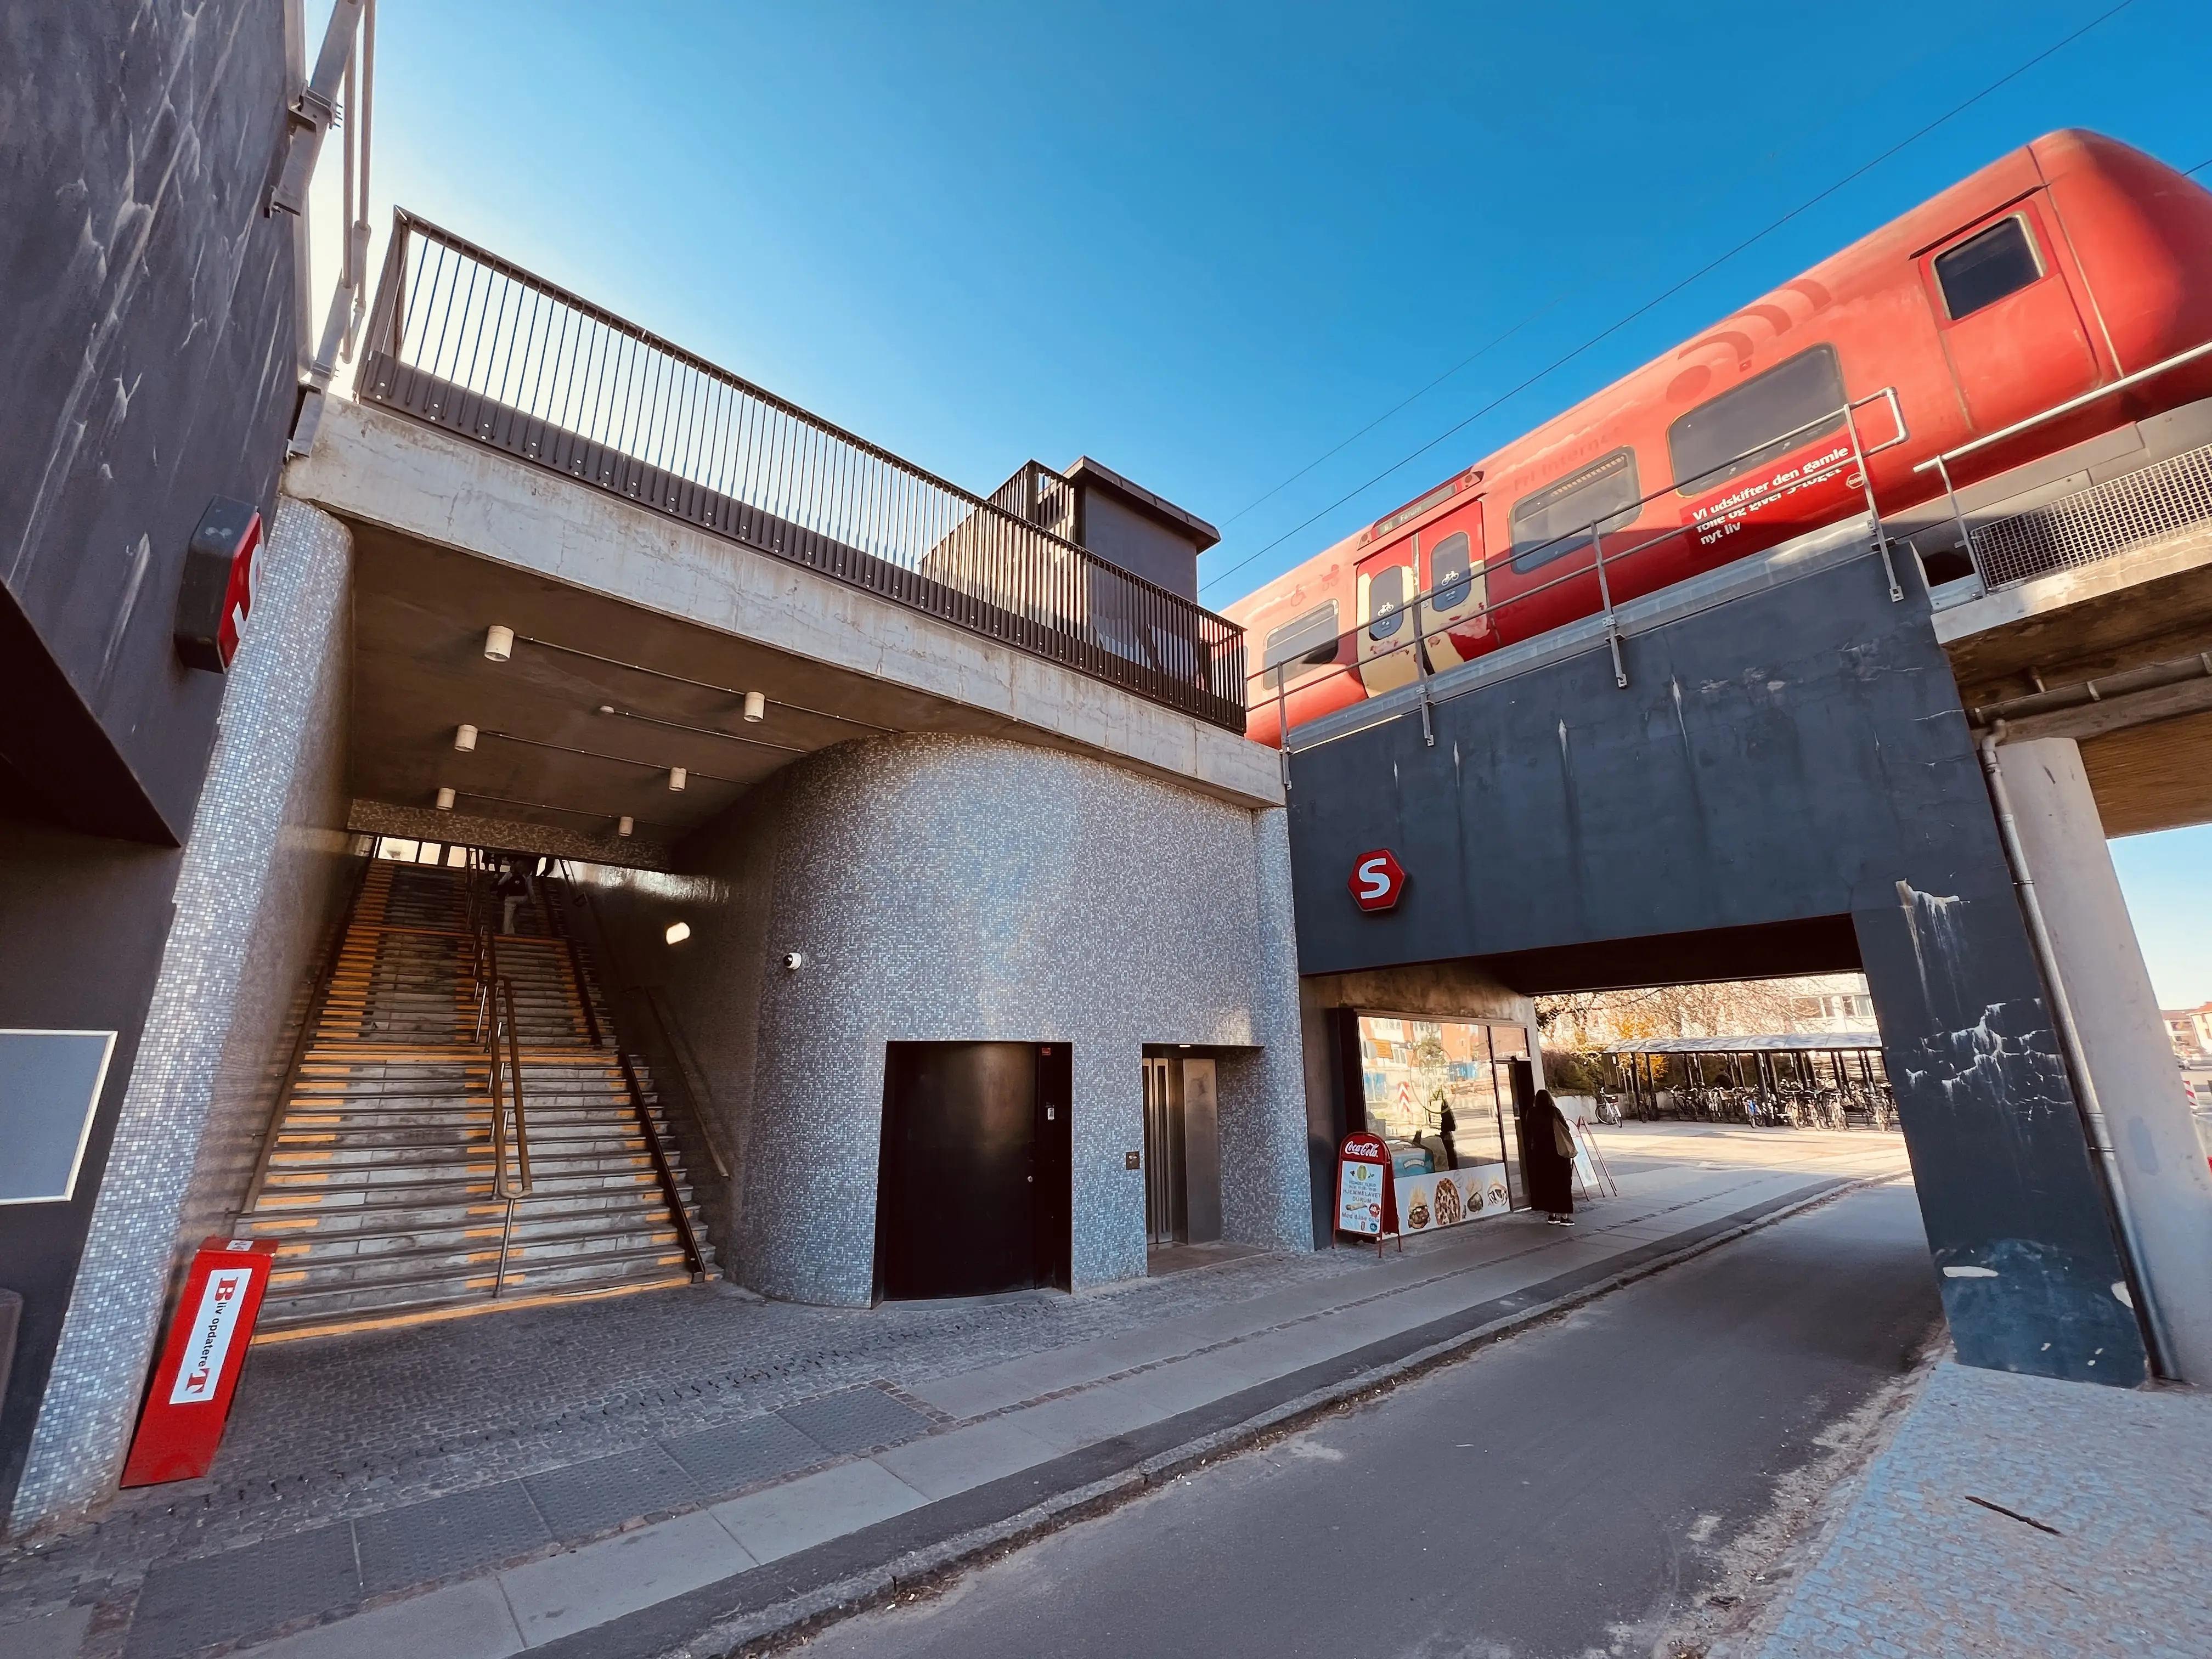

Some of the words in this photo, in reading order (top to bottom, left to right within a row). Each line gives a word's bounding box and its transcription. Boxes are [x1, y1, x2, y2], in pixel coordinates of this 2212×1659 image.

[1692, 507, 1707, 520] Vi
[1709, 482, 1770, 514] udskifter
[1772, 469, 1800, 487] den
[1802, 447, 1849, 473] gamle
[1700, 530, 1724, 545] nyt
[1725, 522, 1741, 535] liv
[1358, 857, 1391, 899] S
[215, 1277, 239, 1314] Bliv
